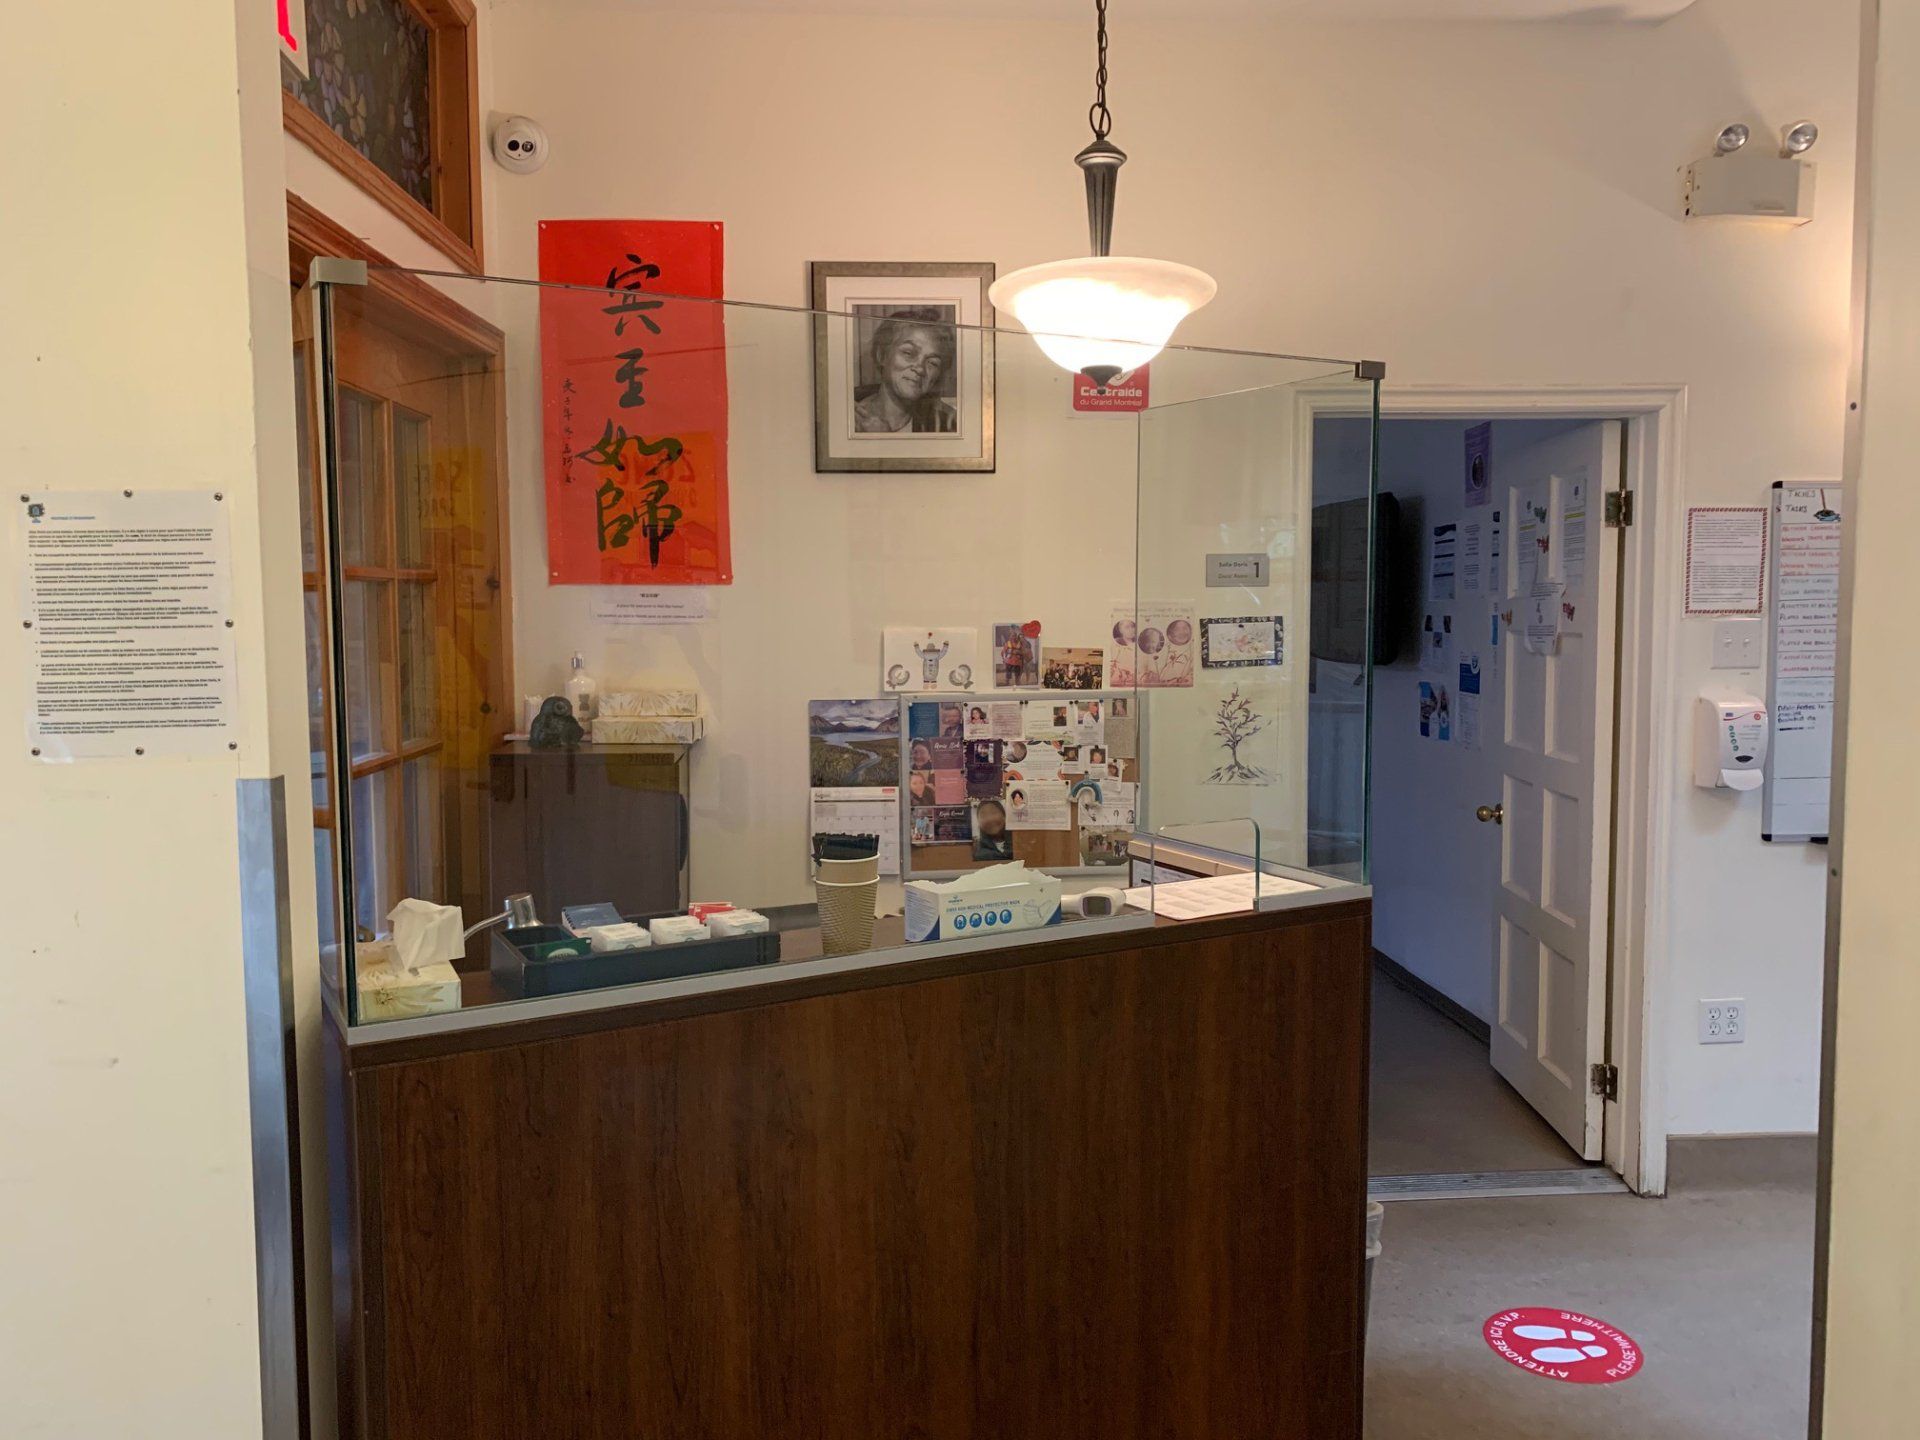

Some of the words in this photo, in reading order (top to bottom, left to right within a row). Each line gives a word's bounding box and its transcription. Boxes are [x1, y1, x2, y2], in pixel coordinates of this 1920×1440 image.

[1080, 386, 1143, 397] Cetraide
[1253, 562, 1260, 578] 1
[1560, 1312, 1605, 1330] HERE
[1489, 1326, 1503, 1338] ICI
[1601, 1329, 1632, 1349] WAIT
[1492, 1339, 1569, 1378] ATTENDRE
[1606, 1350, 1637, 1377] PLEASE
